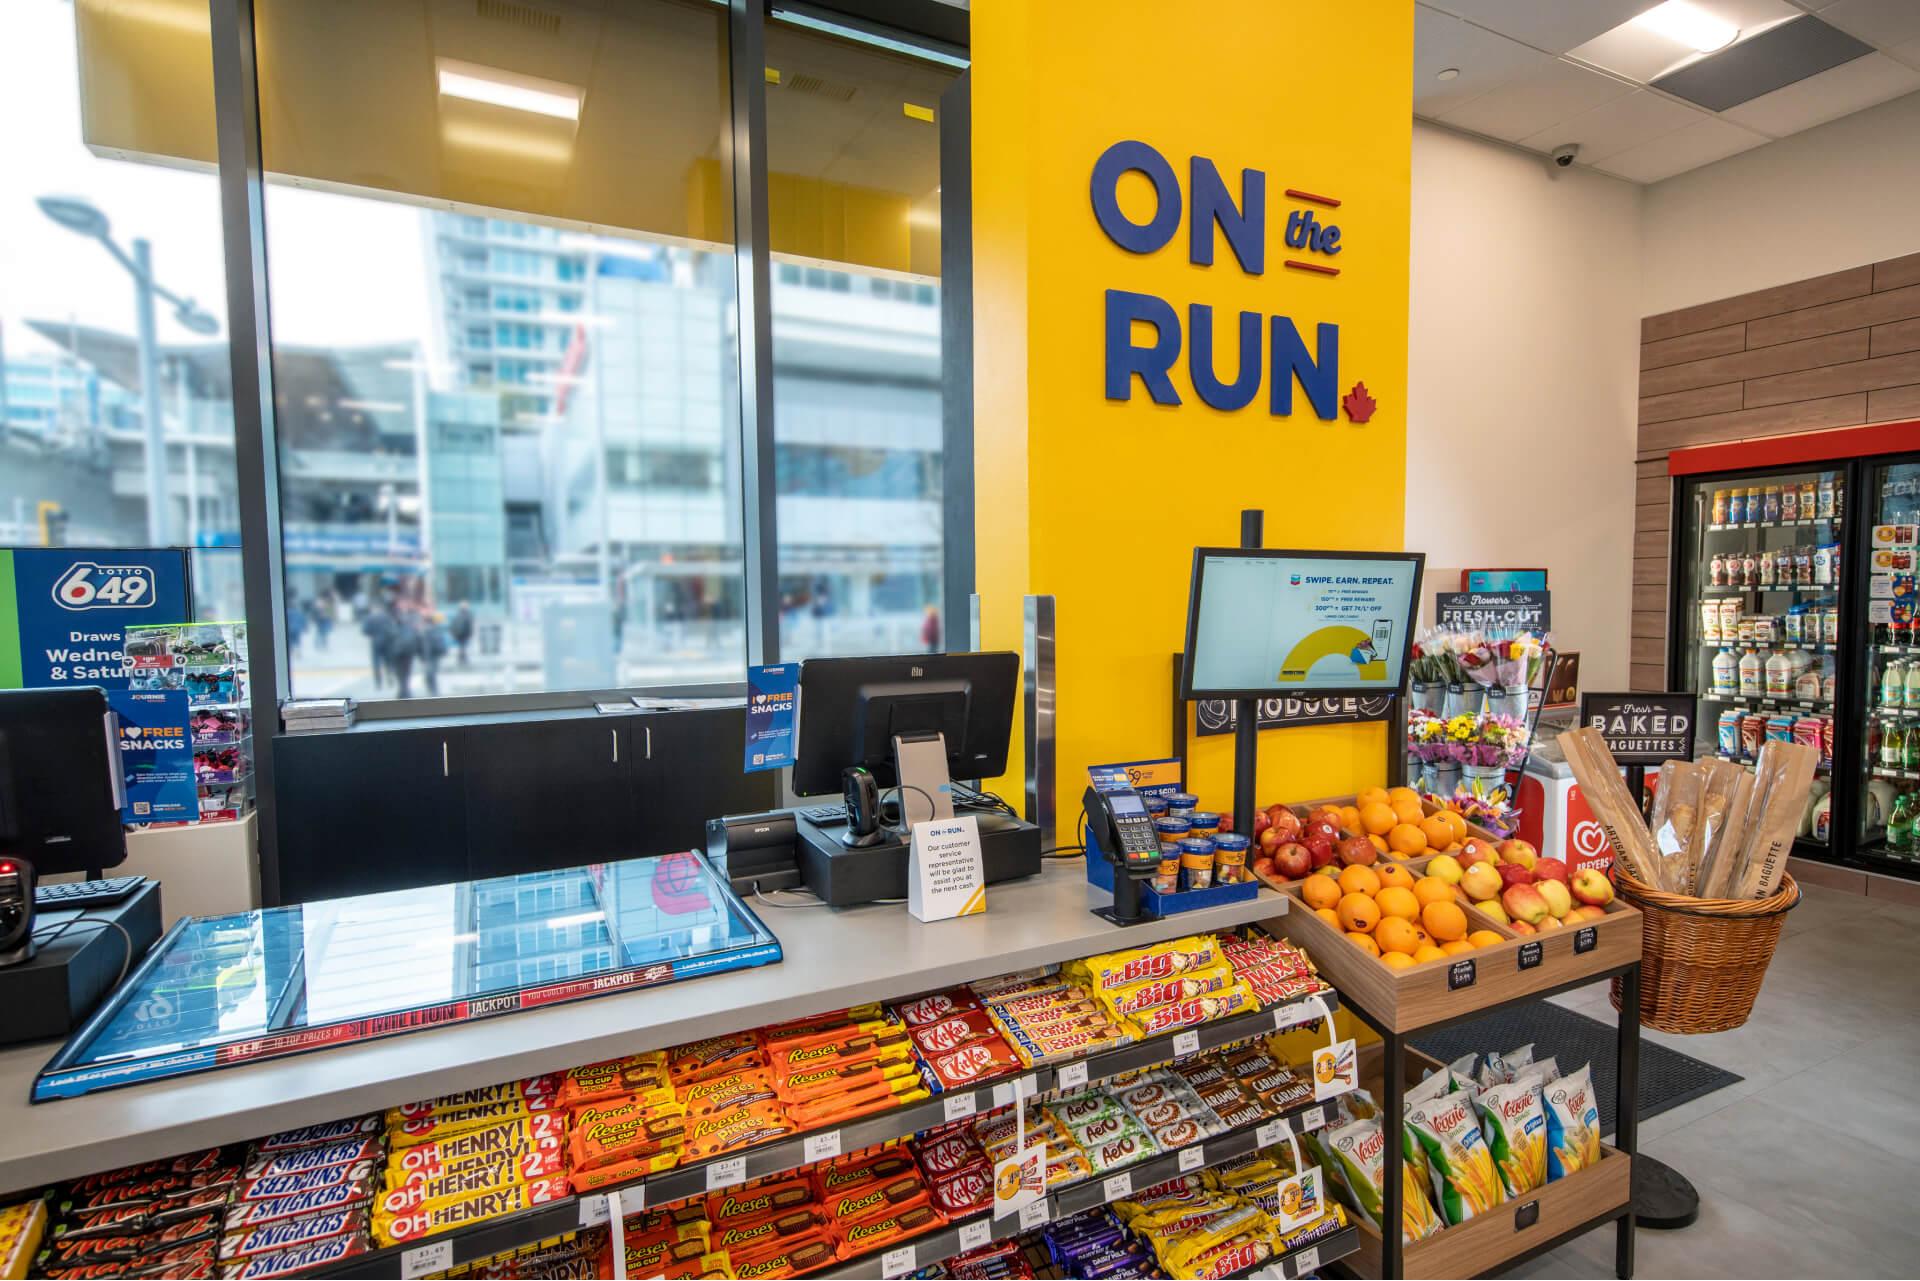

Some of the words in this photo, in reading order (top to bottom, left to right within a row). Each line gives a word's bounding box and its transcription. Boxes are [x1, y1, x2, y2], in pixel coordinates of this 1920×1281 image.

[1090, 140, 1265, 275] ON
[1285, 210, 1342, 256] the
[1105, 289, 1339, 421] RUN
[98, 568, 142, 576] LOTTO
[1305, 576, 1333, 584] SWIPE.
[1362, 577, 1394, 585] REPEAT.
[1470, 594, 1511, 606] Flowers
[70, 631, 121, 643] Draws
[51, 667, 68, 680] &
[751, 702, 792, 714] SNACKS
[767, 692, 792, 703] FREE
[1623, 704, 1652, 714] Fresh
[143, 727, 183, 737] FREE
[1590, 715, 1689, 735] BAKED
[120, 740, 185, 751] SNACKS
[1606, 740, 1675, 751] AGUETTES
[930, 829, 941, 837] ON
[1605, 825, 1628, 862] ARTISAN
[939, 850, 962, 859] service
[941, 841, 971, 850] customer
[928, 857, 974, 869] representative
[930, 869, 941, 878] will
[952, 866, 966, 875] glad
[1759, 840, 1782, 887] BAGUETTE
[933, 877, 951, 885] assist
[952, 876, 964, 884] you
[1125, 951, 1174, 980] Big
[1233, 959, 1293, 991] TWIX
[592, 972, 635, 991] JACKPOT
[1136, 978, 1184, 1008] Big
[470, 995, 518, 1016] JACKPOT
[913, 996, 950, 1023] KitKat
[1154, 998, 1204, 1029] Big
[928, 1022, 969, 1050] KitKat
[1053, 1038, 1089, 1051] CRISP
[787, 1043, 839, 1065] Reese's
[948, 1047, 989, 1078] KitKat
[567, 1062, 621, 1080] Reese's
[579, 1078, 594, 1086] BIG
[595, 1075, 612, 1083] CUP
[787, 1067, 839, 1088] Reese's
[1189, 1066, 1226, 1087] ARAMILK
[1252, 1070, 1294, 1092] CARAMILK
[687, 1074, 742, 1102] Reese's
[1136, 1084, 1153, 1099] Aero
[1204, 1086, 1241, 1108] ARAMILK
[1271, 1083, 1312, 1105] CARAMILK
[577, 1103, 635, 1127] Reese's
[1066, 1099, 1098, 1122] Aero
[1153, 1103, 1170, 1120] Aero
[1499, 1093, 1534, 1120] Veggie
[586, 1116, 646, 1142] Reese's
[693, 1108, 751, 1140] Reese's
[1086, 1118, 1118, 1144] Aero
[1170, 1121, 1187, 1139] Aero
[1427, 1106, 1465, 1135] Veggie
[1525, 1117, 1543, 1131] Original
[401, 1143, 441, 1171] OH
[442, 1119, 525, 1159] HENRY!
[532, 1114, 552, 1140] 2
[601, 1136, 617, 1145] BIG
[618, 1131, 637, 1140] CUP
[267, 1138, 368, 1176] SNICKERS
[928, 1140, 964, 1171] KitKat
[1102, 1138, 1135, 1165] Aero
[250, 1163, 350, 1197] SNICKERS
[384, 1183, 427, 1212] OH
[428, 1158, 515, 1198] HENRY!
[524, 1152, 543, 1177] 2
[825, 1163, 871, 1189] Reese's
[85, 1177, 178, 1208] Mars
[944, 1176, 983, 1207] KitKat
[225, 1206, 250, 1230] 2
[253, 1181, 352, 1222] SNICKERS
[389, 1211, 432, 1239] OH
[434, 1184, 522, 1226] HENRY!
[532, 1179, 551, 1204] 2
[720, 1194, 771, 1219] Reese's
[837, 1190, 885, 1217] Reese's
[219, 1234, 244, 1260] 2
[245, 1210, 350, 1251] SNICKERS
[721, 1222, 773, 1246] Reese's
[848, 1218, 897, 1243] Reese's
[245, 1236, 350, 1279] SNICKERS
[627, 1261, 643, 1271] BIG
[643, 1256, 660, 1266] CUP
[736, 1255, 788, 1278] Reese's
[1092, 1255, 1112, 1266] DAIRY
[1111, 1249, 1127, 1259] MILK
